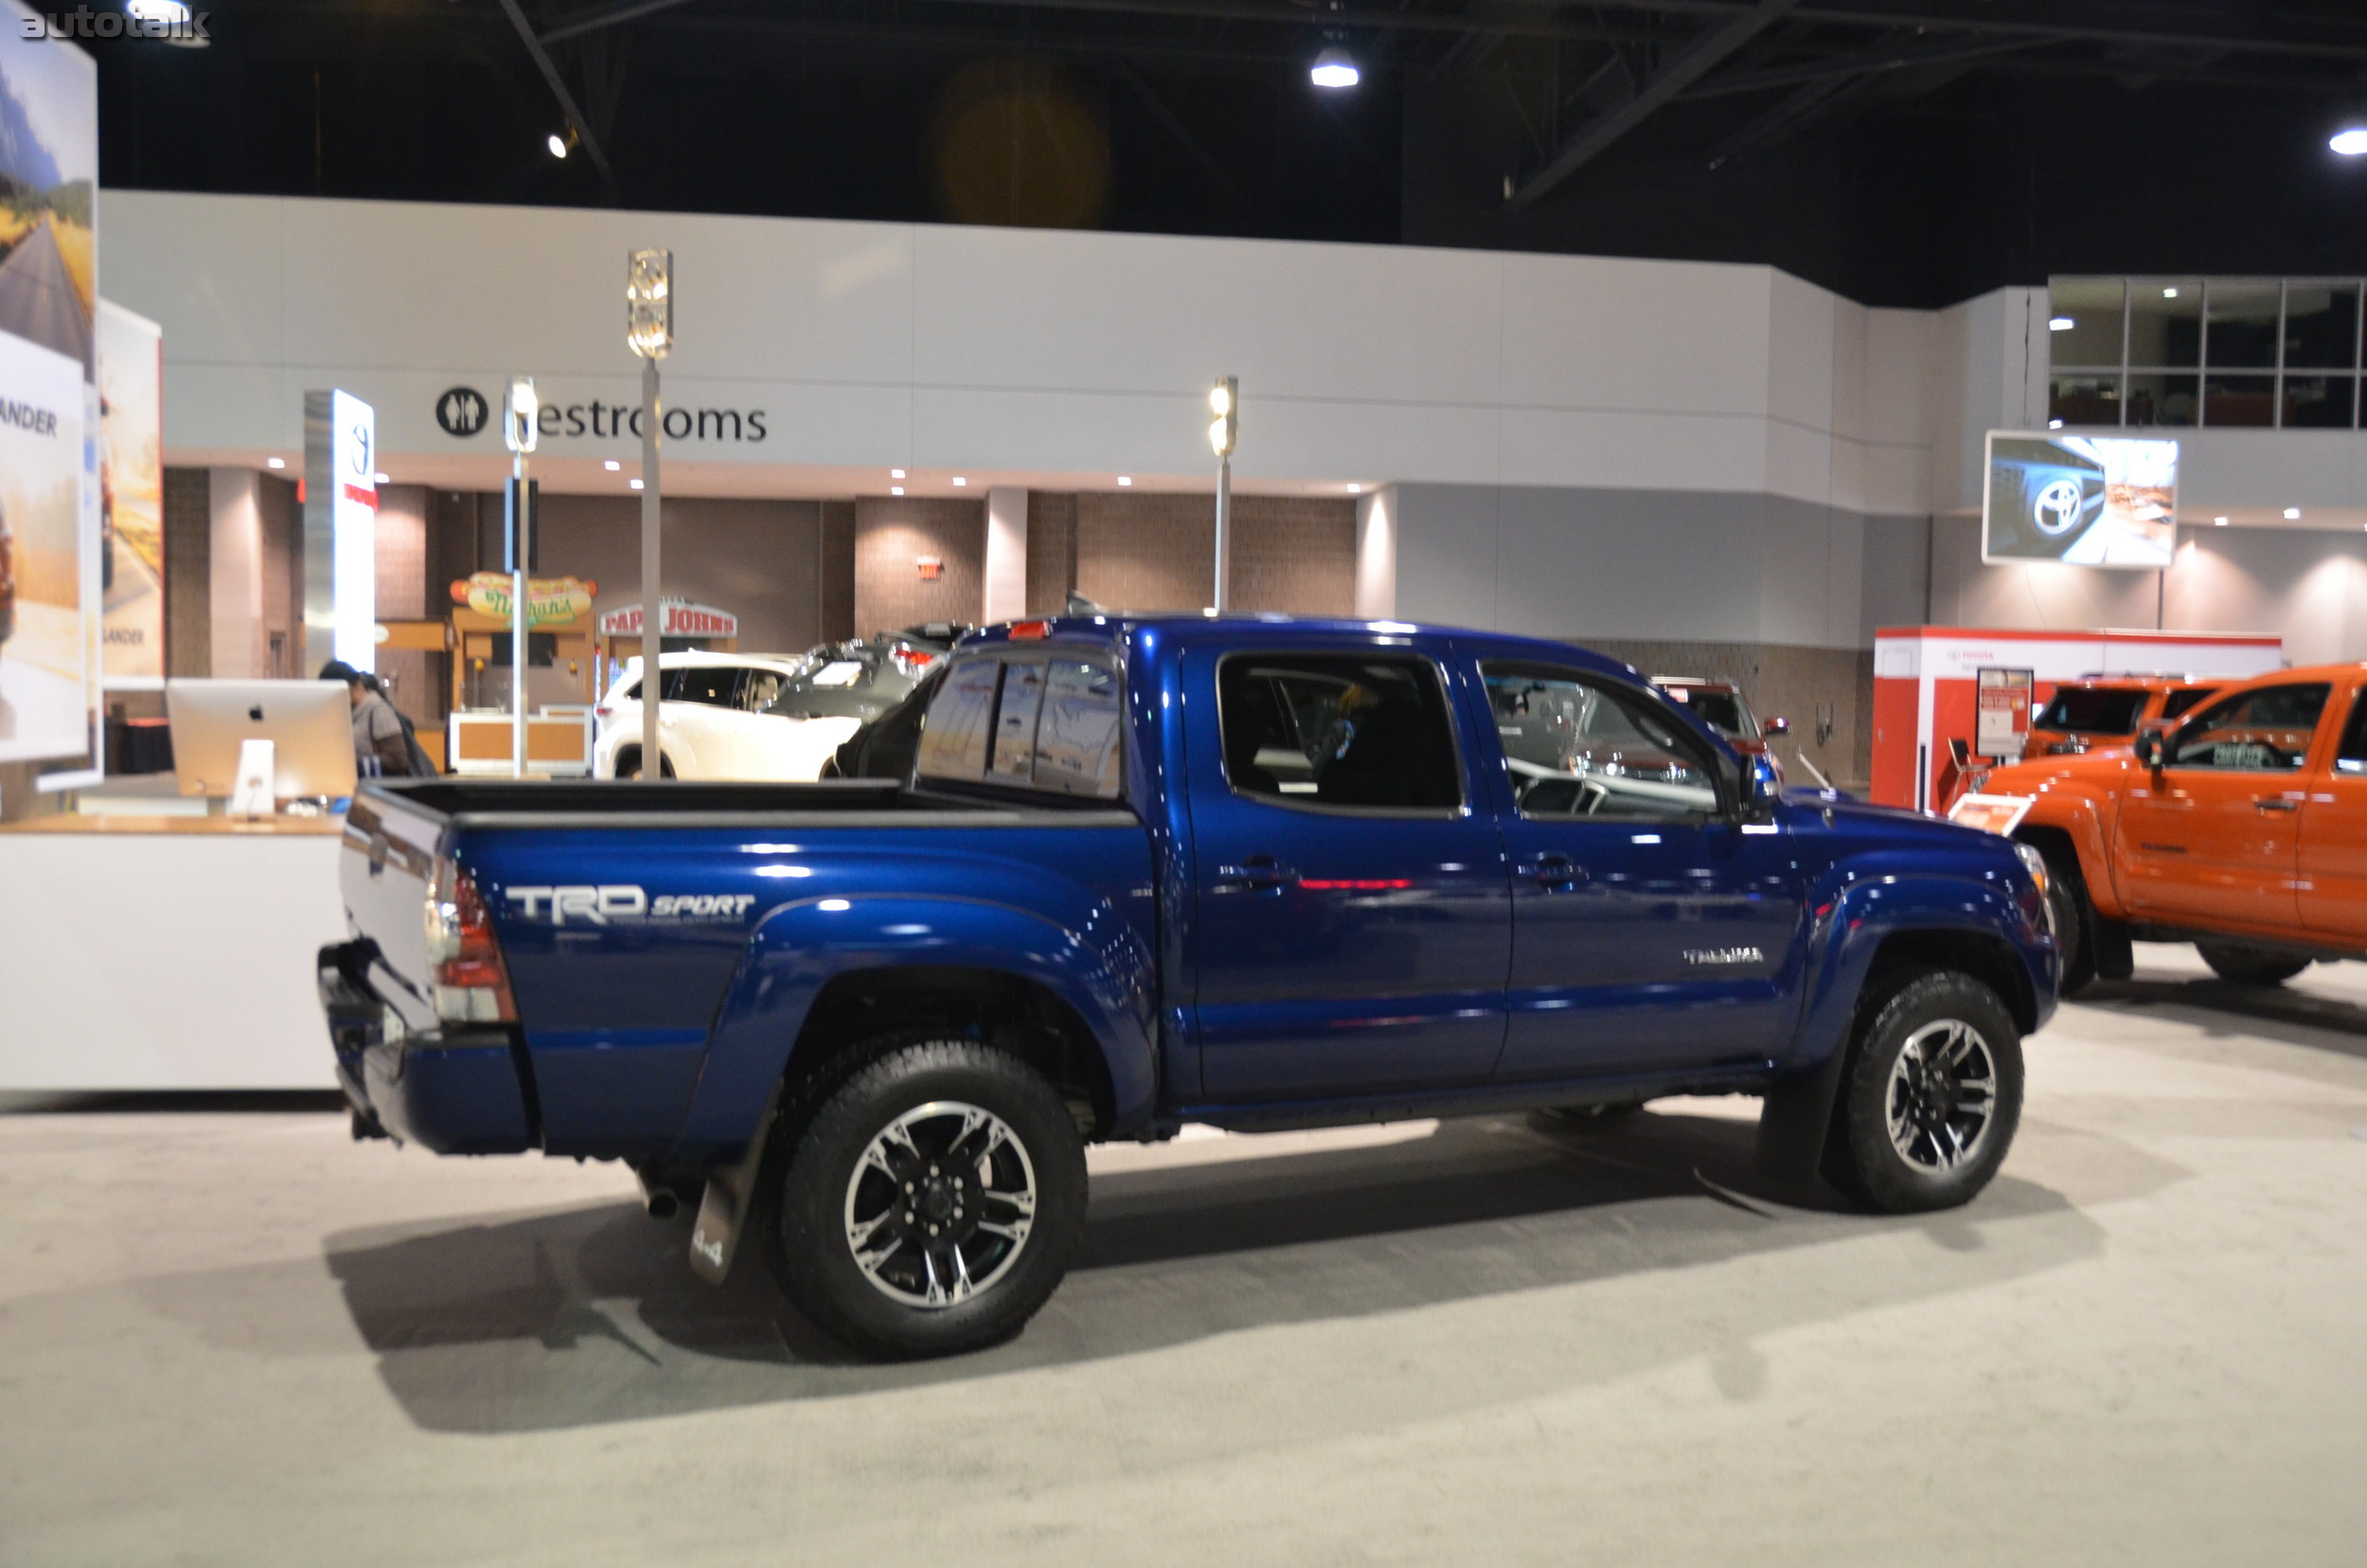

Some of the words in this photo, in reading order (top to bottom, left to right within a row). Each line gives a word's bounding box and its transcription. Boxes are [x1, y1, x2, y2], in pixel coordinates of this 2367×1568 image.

[606, 610, 644, 632] PAP
[505, 884, 649, 926] TRD
[651, 894, 756, 917] SPORT
